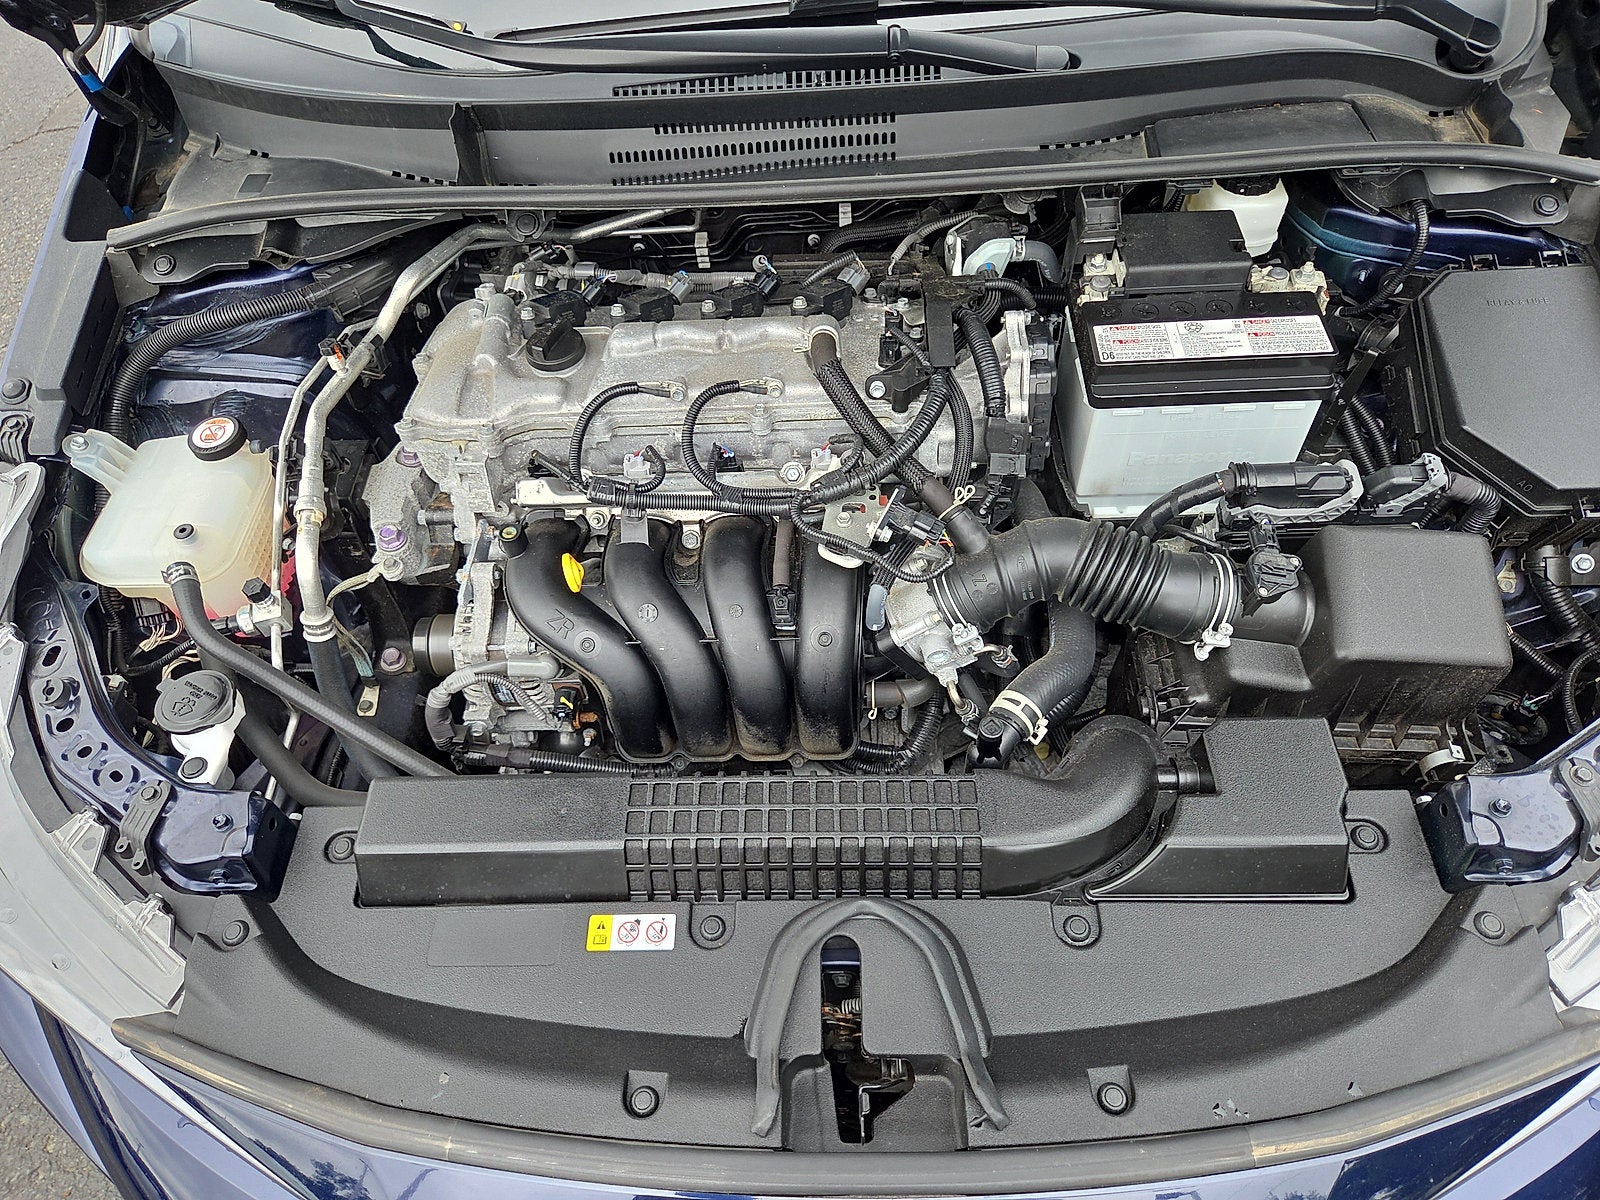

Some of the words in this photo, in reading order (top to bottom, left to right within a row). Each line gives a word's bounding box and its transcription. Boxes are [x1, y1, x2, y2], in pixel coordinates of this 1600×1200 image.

[1102, 351, 1116, 361] D6
[1127, 447, 1256, 466] Panasonic
[545, 608, 575, 640] ZR
